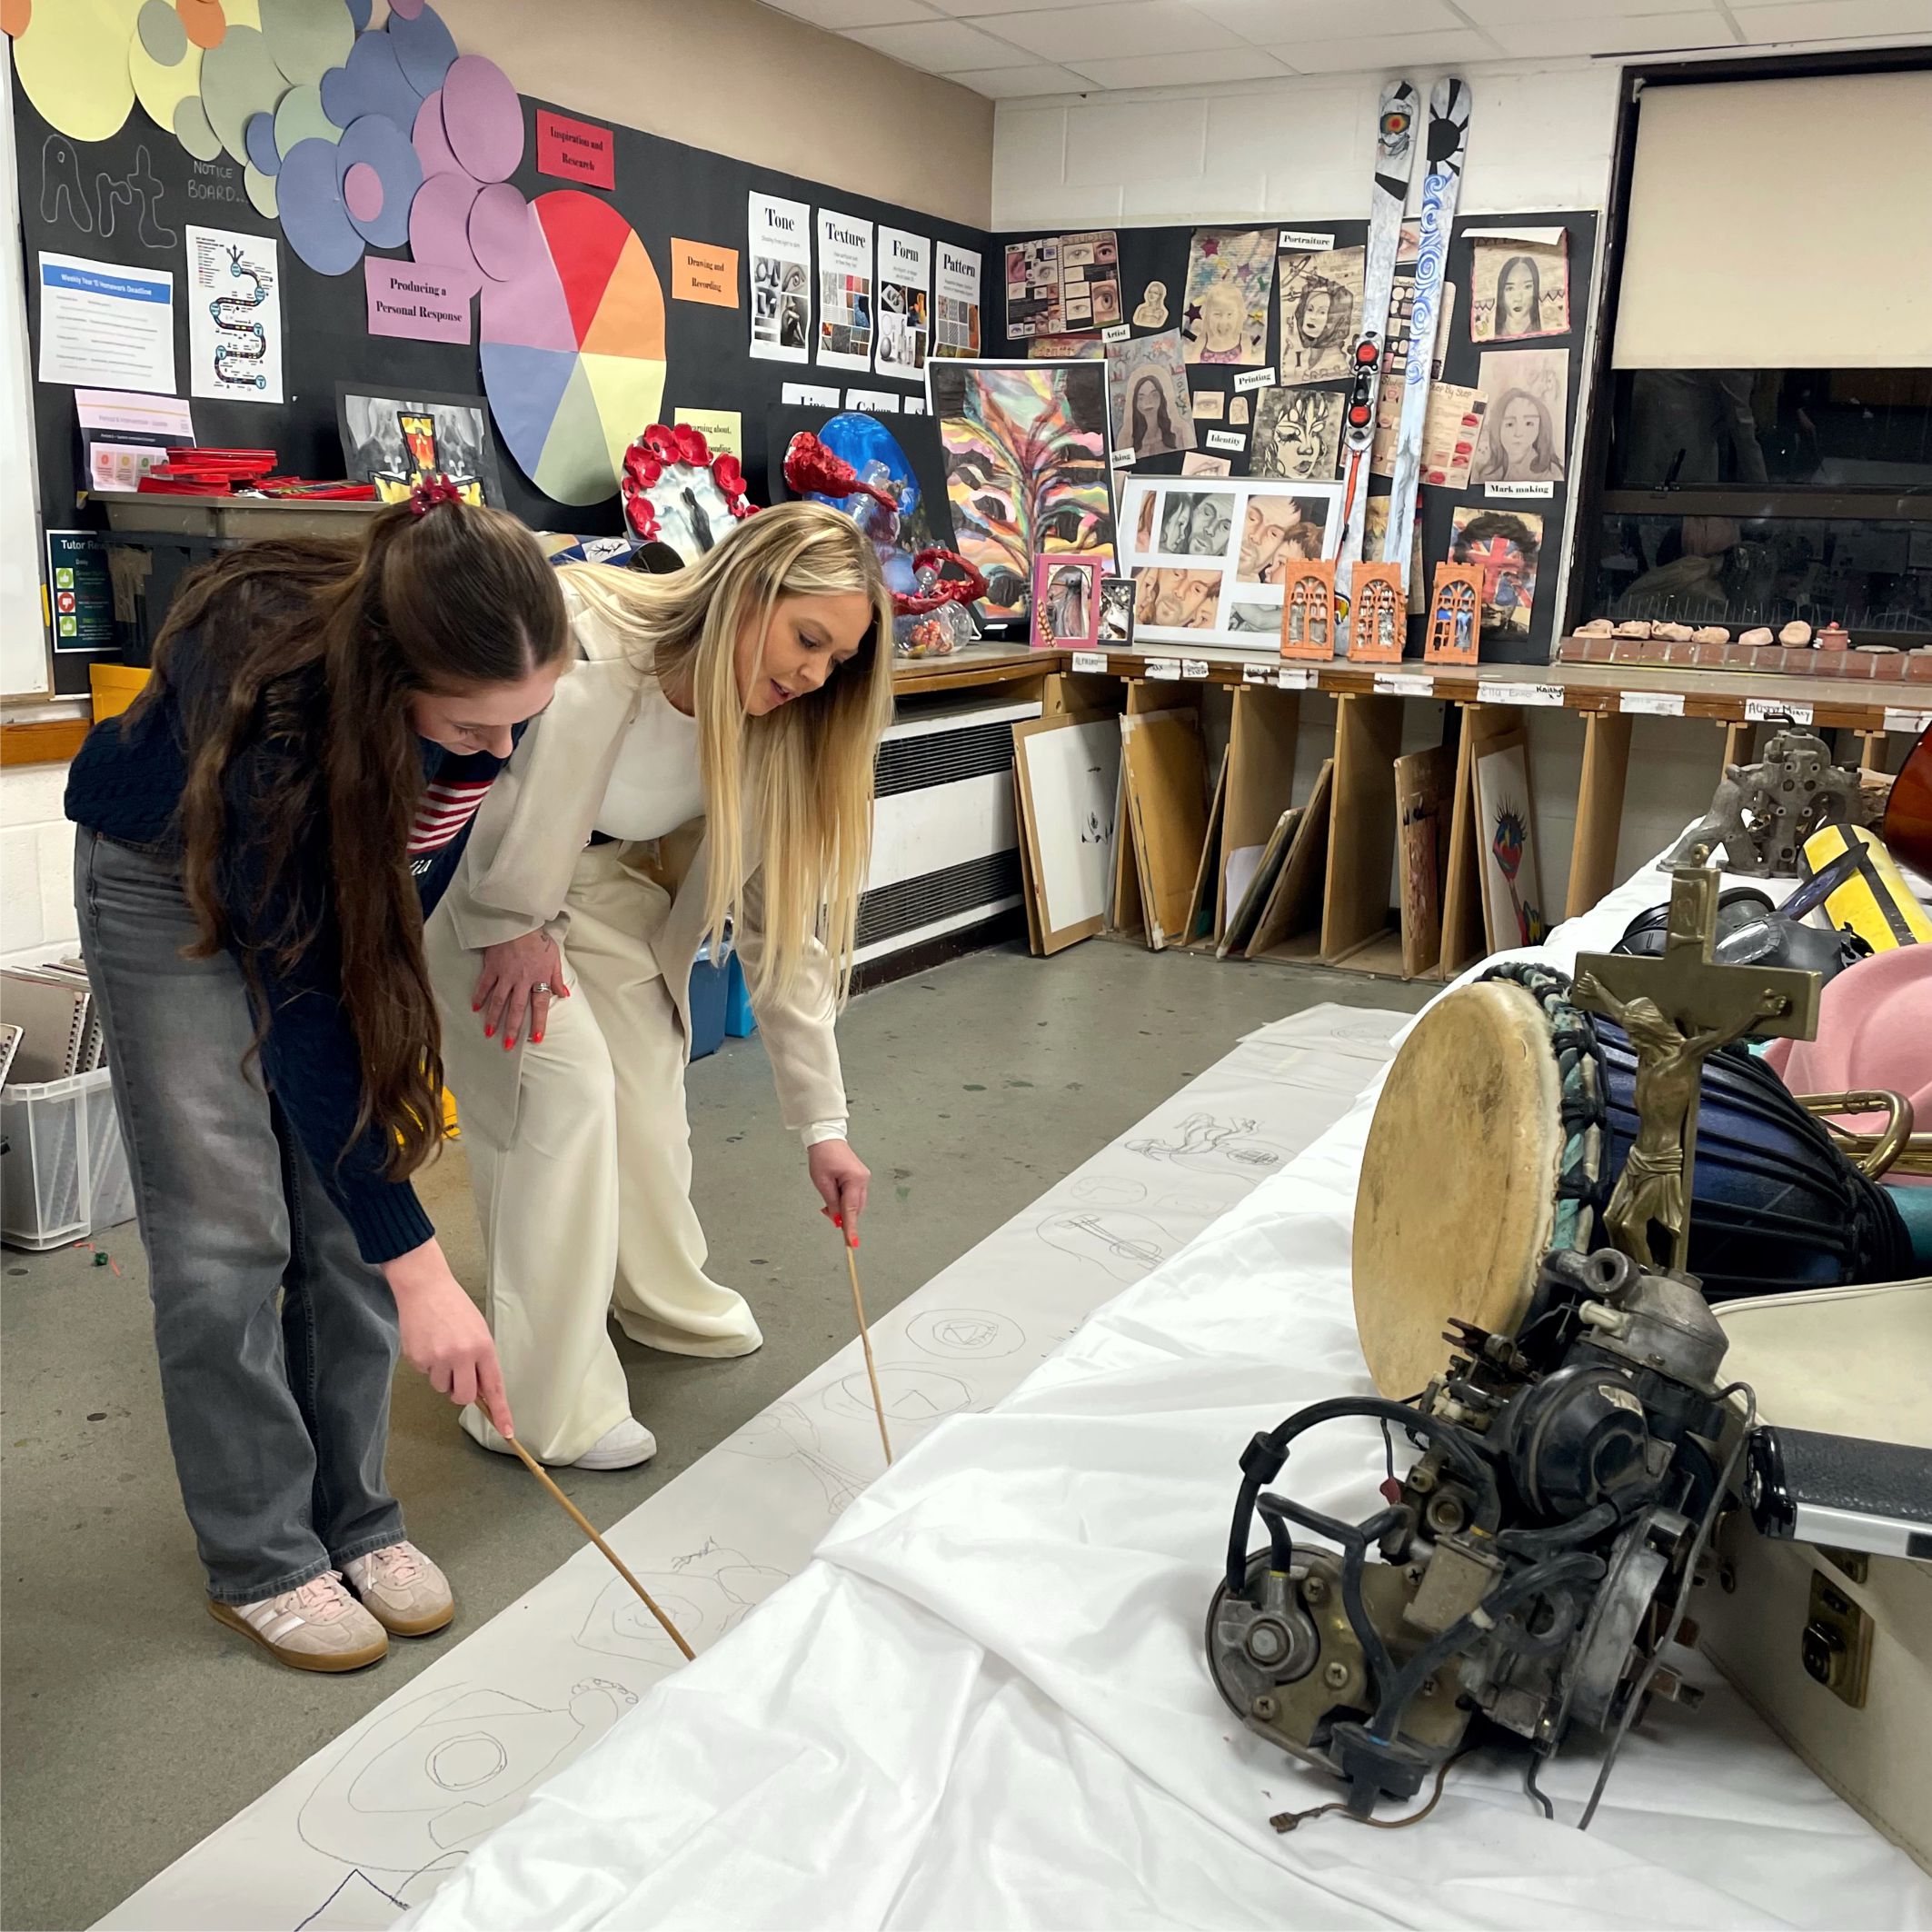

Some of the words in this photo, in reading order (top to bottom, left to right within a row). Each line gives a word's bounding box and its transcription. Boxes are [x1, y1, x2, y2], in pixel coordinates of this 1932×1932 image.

[551, 126, 589, 146] Inspiration
[591, 141, 603, 151] and
[194, 160, 233, 179] NOTICE
[562, 153, 594, 171] Research
[41, 134, 177, 248] Art
[764, 208, 795, 231] Tone
[825, 223, 866, 248] Texture
[1284, 234, 1330, 245] Portraiture
[893, 240, 919, 262] Form
[688, 256, 712, 271] Drawing
[714, 264, 724, 272] and
[943, 254, 976, 278] Pattern
[390, 278, 440, 296] Producing
[442, 288, 446, 296] a
[692, 277, 722, 293] Recording
[376, 301, 416, 317] Personal
[419, 306, 463, 323] Response
[1106, 330, 1126, 339] Artist
[1239, 373, 1271, 385] Printing
[1211, 434, 1240, 446] Identity
[1491, 484, 1513, 493] Mark
[1516, 485, 1549, 493] making
[61, 540, 85, 550] Tutor
